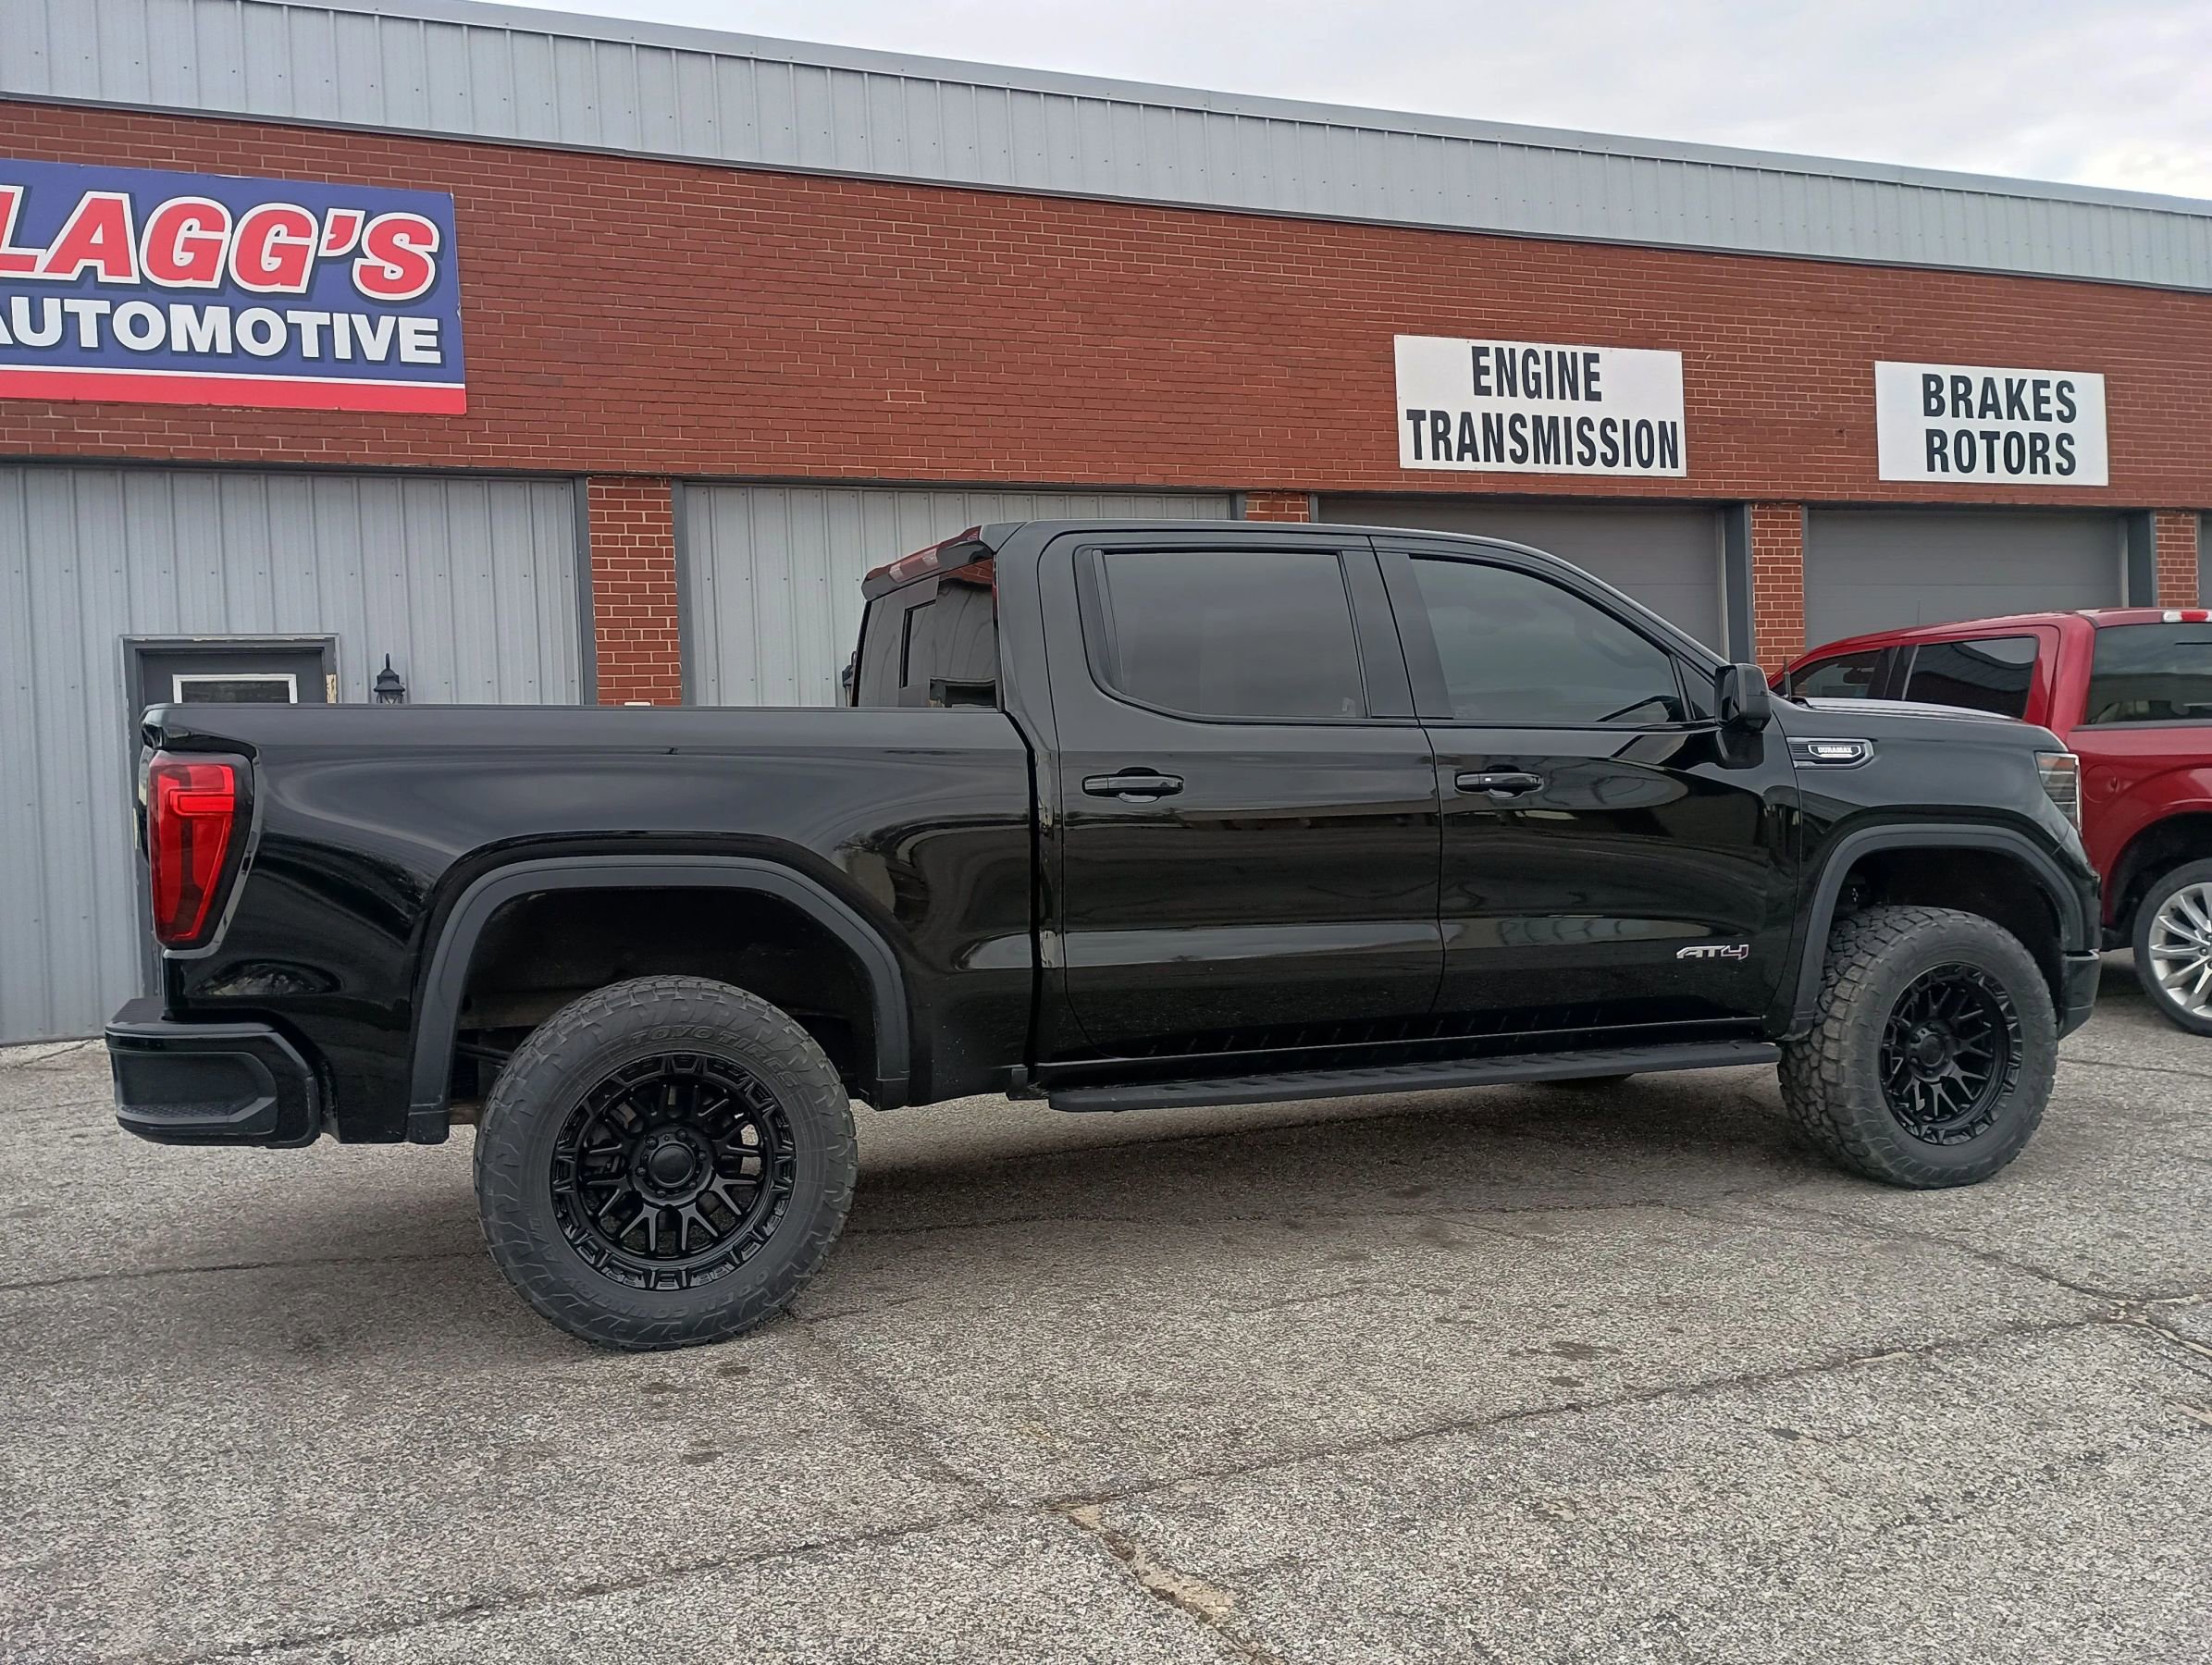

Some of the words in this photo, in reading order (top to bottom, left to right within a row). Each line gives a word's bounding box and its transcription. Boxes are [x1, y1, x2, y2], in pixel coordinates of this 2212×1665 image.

[0, 296, 441, 364] UTOMOTIVE
[1471, 345, 1602, 402] ENGINE
[1922, 373, 2077, 424] BRAKES
[1405, 408, 1680, 470] TRANSMISSION
[1925, 428, 2077, 476] ROTORS
[1675, 944, 1749, 961] AT4
[630, 1024, 715, 1045] TOYO
